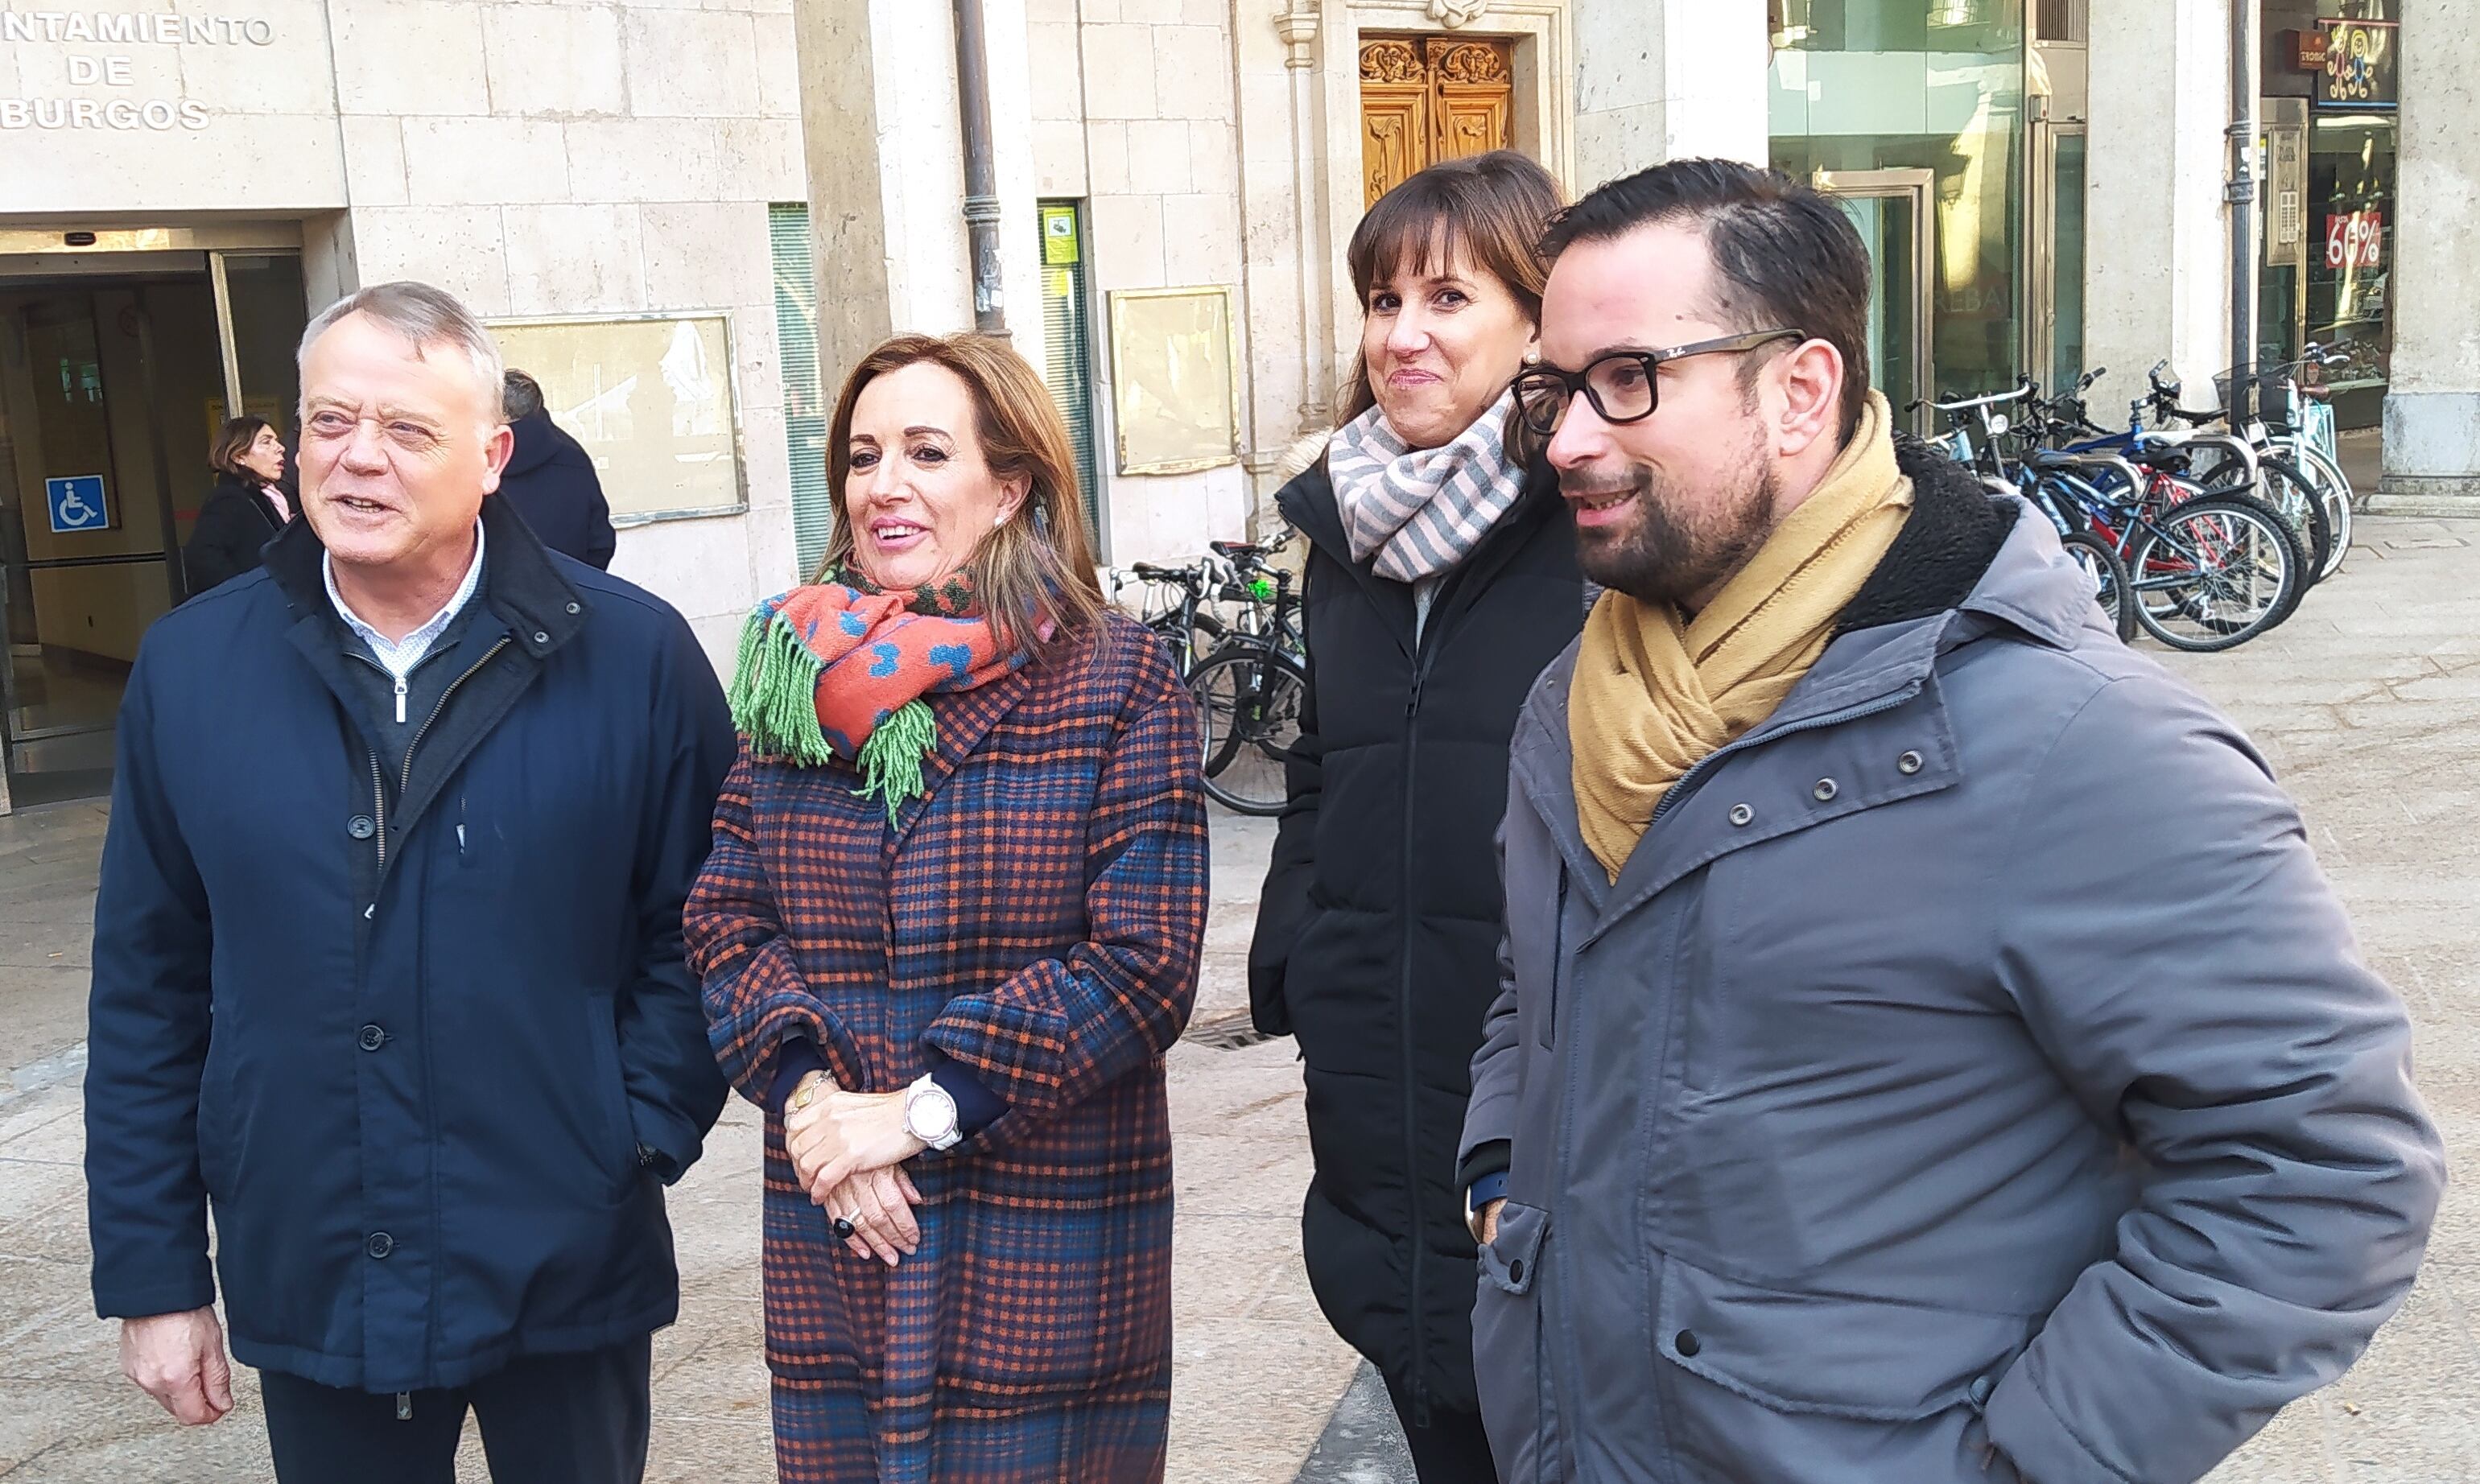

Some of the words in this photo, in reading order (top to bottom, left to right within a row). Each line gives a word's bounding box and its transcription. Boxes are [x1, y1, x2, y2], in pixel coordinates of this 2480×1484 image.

[3, 12, 275, 45] NTAMIENTO
[68, 56, 134, 85] DE
[0, 98, 209, 130] BURGOS
[2329, 221, 2379, 265] 60%
